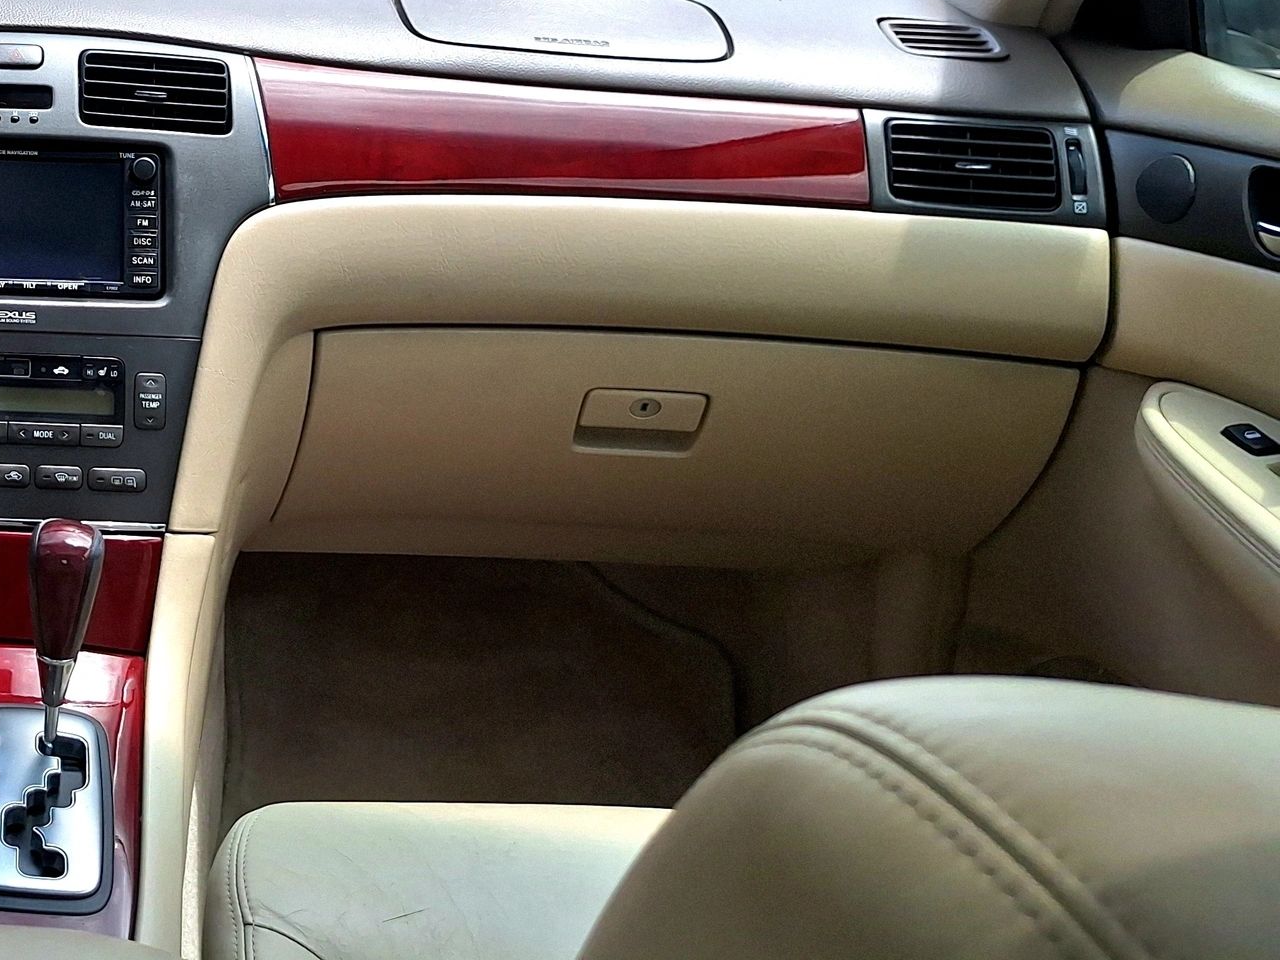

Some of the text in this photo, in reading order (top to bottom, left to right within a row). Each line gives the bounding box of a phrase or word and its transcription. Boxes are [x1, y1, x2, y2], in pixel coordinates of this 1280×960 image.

[133, 238, 152, 246] DISC
[131, 257, 154, 265] SCAN
[133, 275, 152, 284] INFO
[22, 281, 37, 289] TILT
[57, 282, 78, 290] OPEN
[33, 430, 54, 439] MODE
[98, 431, 116, 440] DUAL
